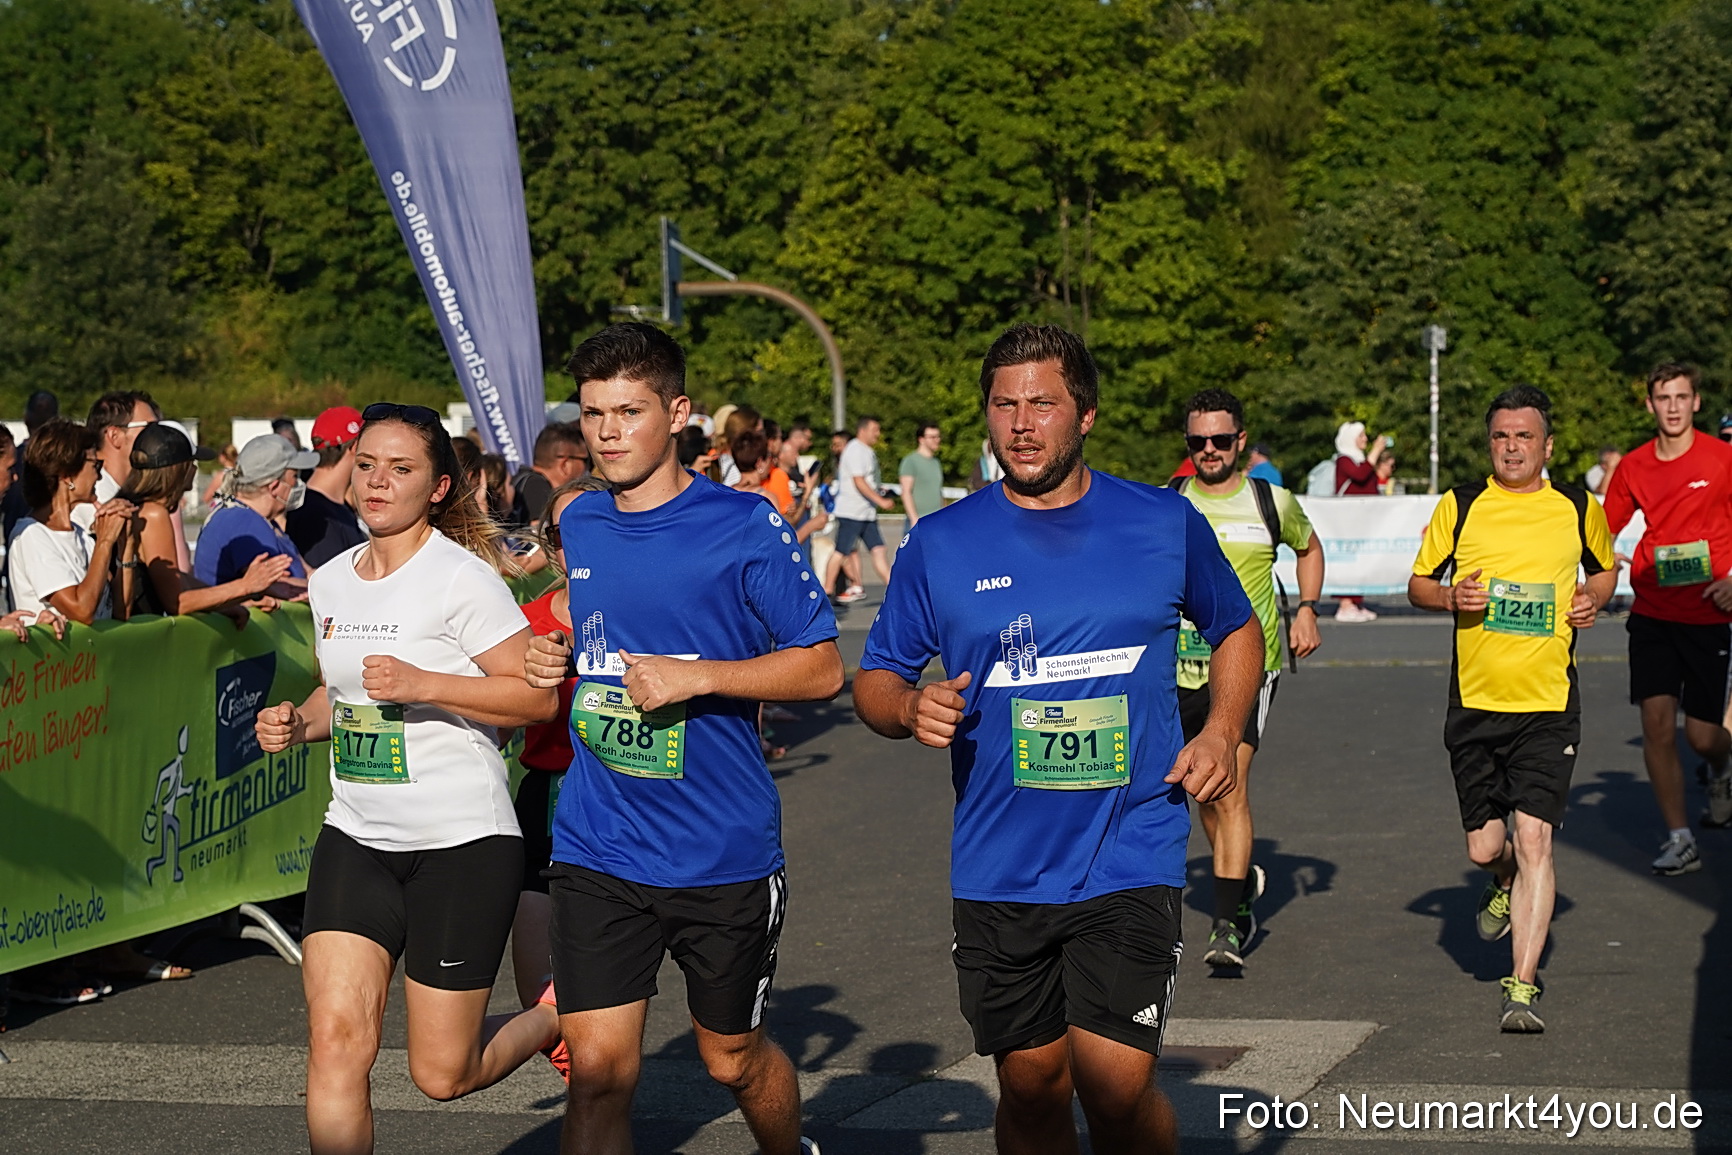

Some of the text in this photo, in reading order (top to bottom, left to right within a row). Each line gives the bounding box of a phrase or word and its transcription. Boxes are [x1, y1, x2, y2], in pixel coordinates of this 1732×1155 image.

[1665, 556, 1701, 573] 1689
[974, 575, 1012, 592] JAKO
[1497, 598, 1544, 620] 1241
[336, 624, 399, 634] SCHWARZ
[1496, 617, 1524, 627] Hausner
[1045, 652, 1130, 670] Schornsteintechnik
[33, 651, 97, 700] Firmen
[1047, 667, 1091, 679] Neumarkt
[600, 701, 635, 711] Firmenlauf
[42, 686, 111, 761] länger!
[1039, 716, 1078, 725] Firmenlauf
[598, 715, 654, 749] 788
[333, 736, 341, 763] RUN
[343, 730, 379, 758] 177
[594, 743, 658, 763] Roth Joshua
[666, 729, 679, 768] 2022
[1018, 739, 1029, 769] RUN
[1039, 730, 1098, 760] 791
[1114, 732, 1125, 772] 2022
[367, 760, 393, 769] Davina
[390, 737, 403, 774] 2022
[1028, 761, 1115, 773] Kosmehl Tobias
[190, 823, 248, 872] neumarkt
[1132, 1014, 1159, 1029] adidas
